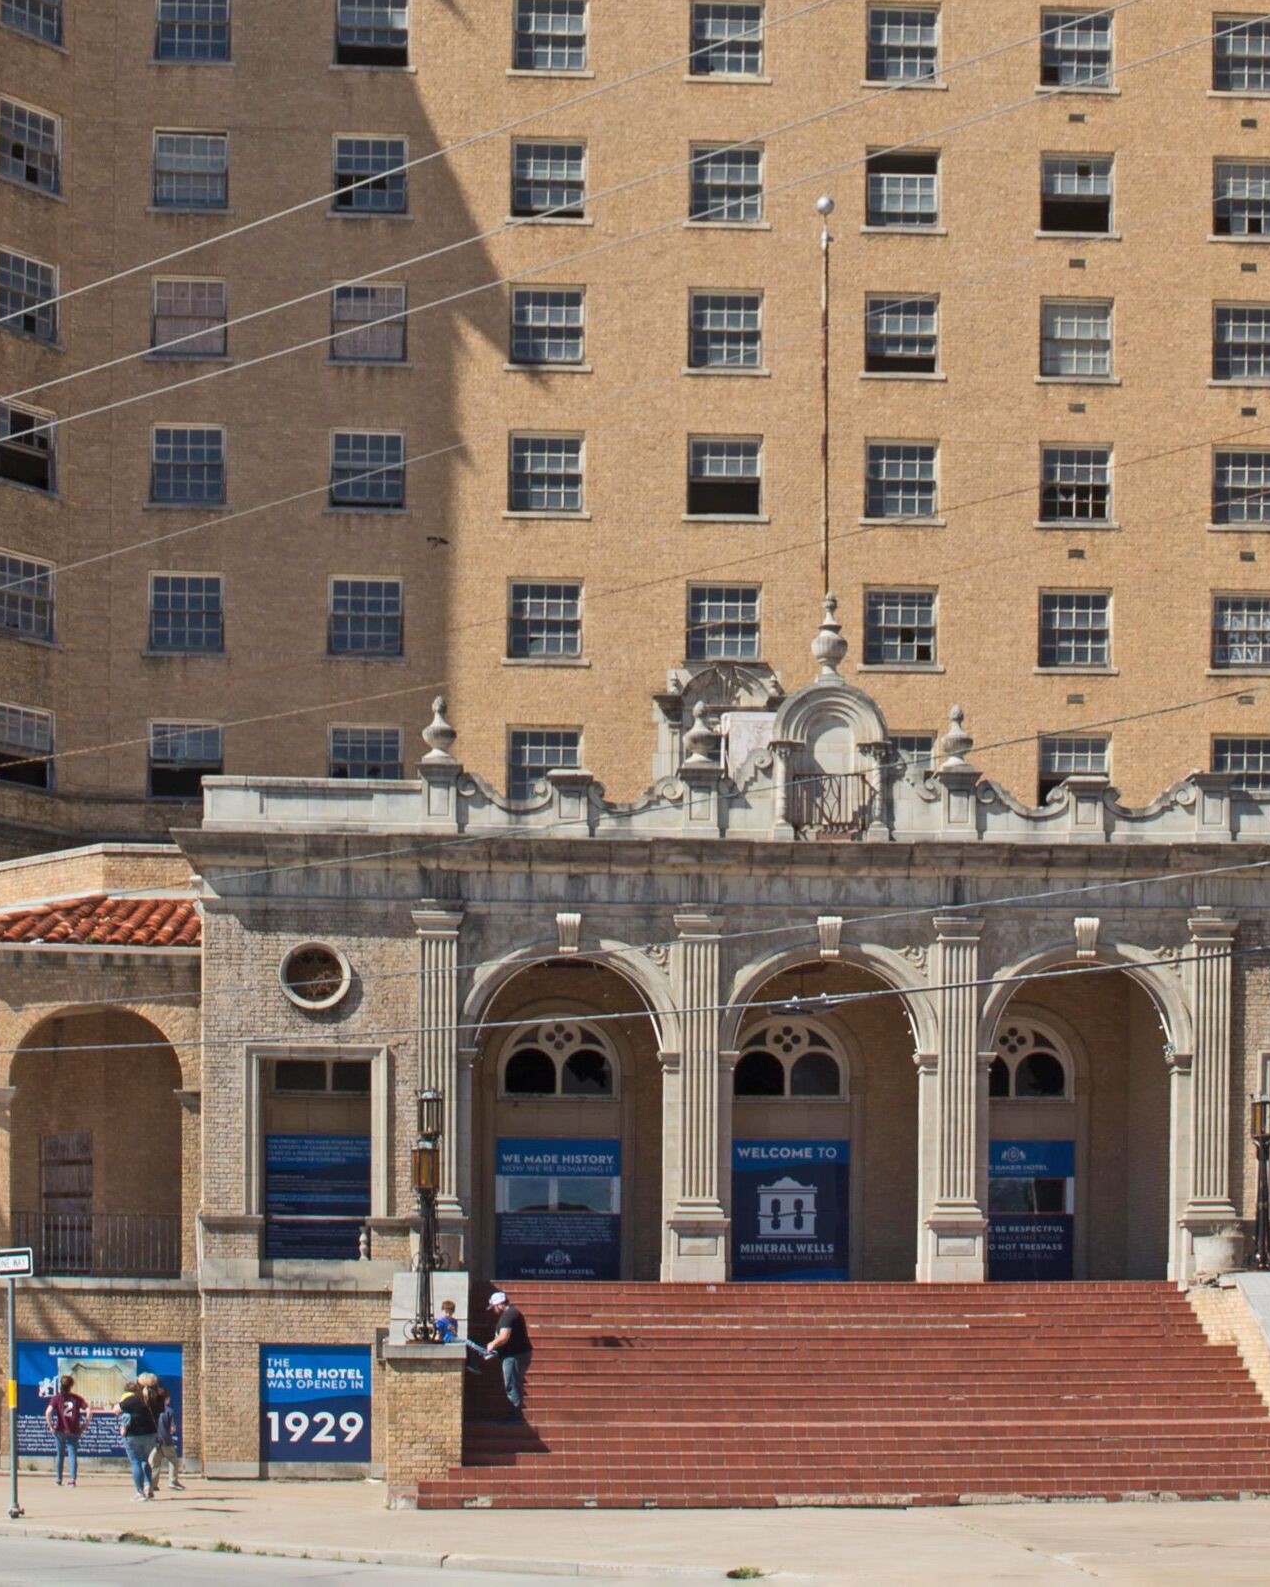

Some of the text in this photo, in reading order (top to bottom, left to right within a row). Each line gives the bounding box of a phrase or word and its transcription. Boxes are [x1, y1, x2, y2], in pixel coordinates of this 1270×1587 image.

[738, 1147, 837, 1158] WELCOME TO
[502, 1154, 521, 1164] WE
[524, 1155, 559, 1164] MADE
[740, 1243, 834, 1253] MINERAL WELLS
[12, 1258, 26, 1268] WAY
[48, 1346, 146, 1357] BAKER HISTORY
[266, 1358, 290, 1368] THE
[266, 1368, 364, 1379] BAKER HOTEL
[266, 1380, 364, 1389] WAS OPENED IN
[63, 1402, 73, 1417] 2
[266, 1411, 364, 1442] 1929
